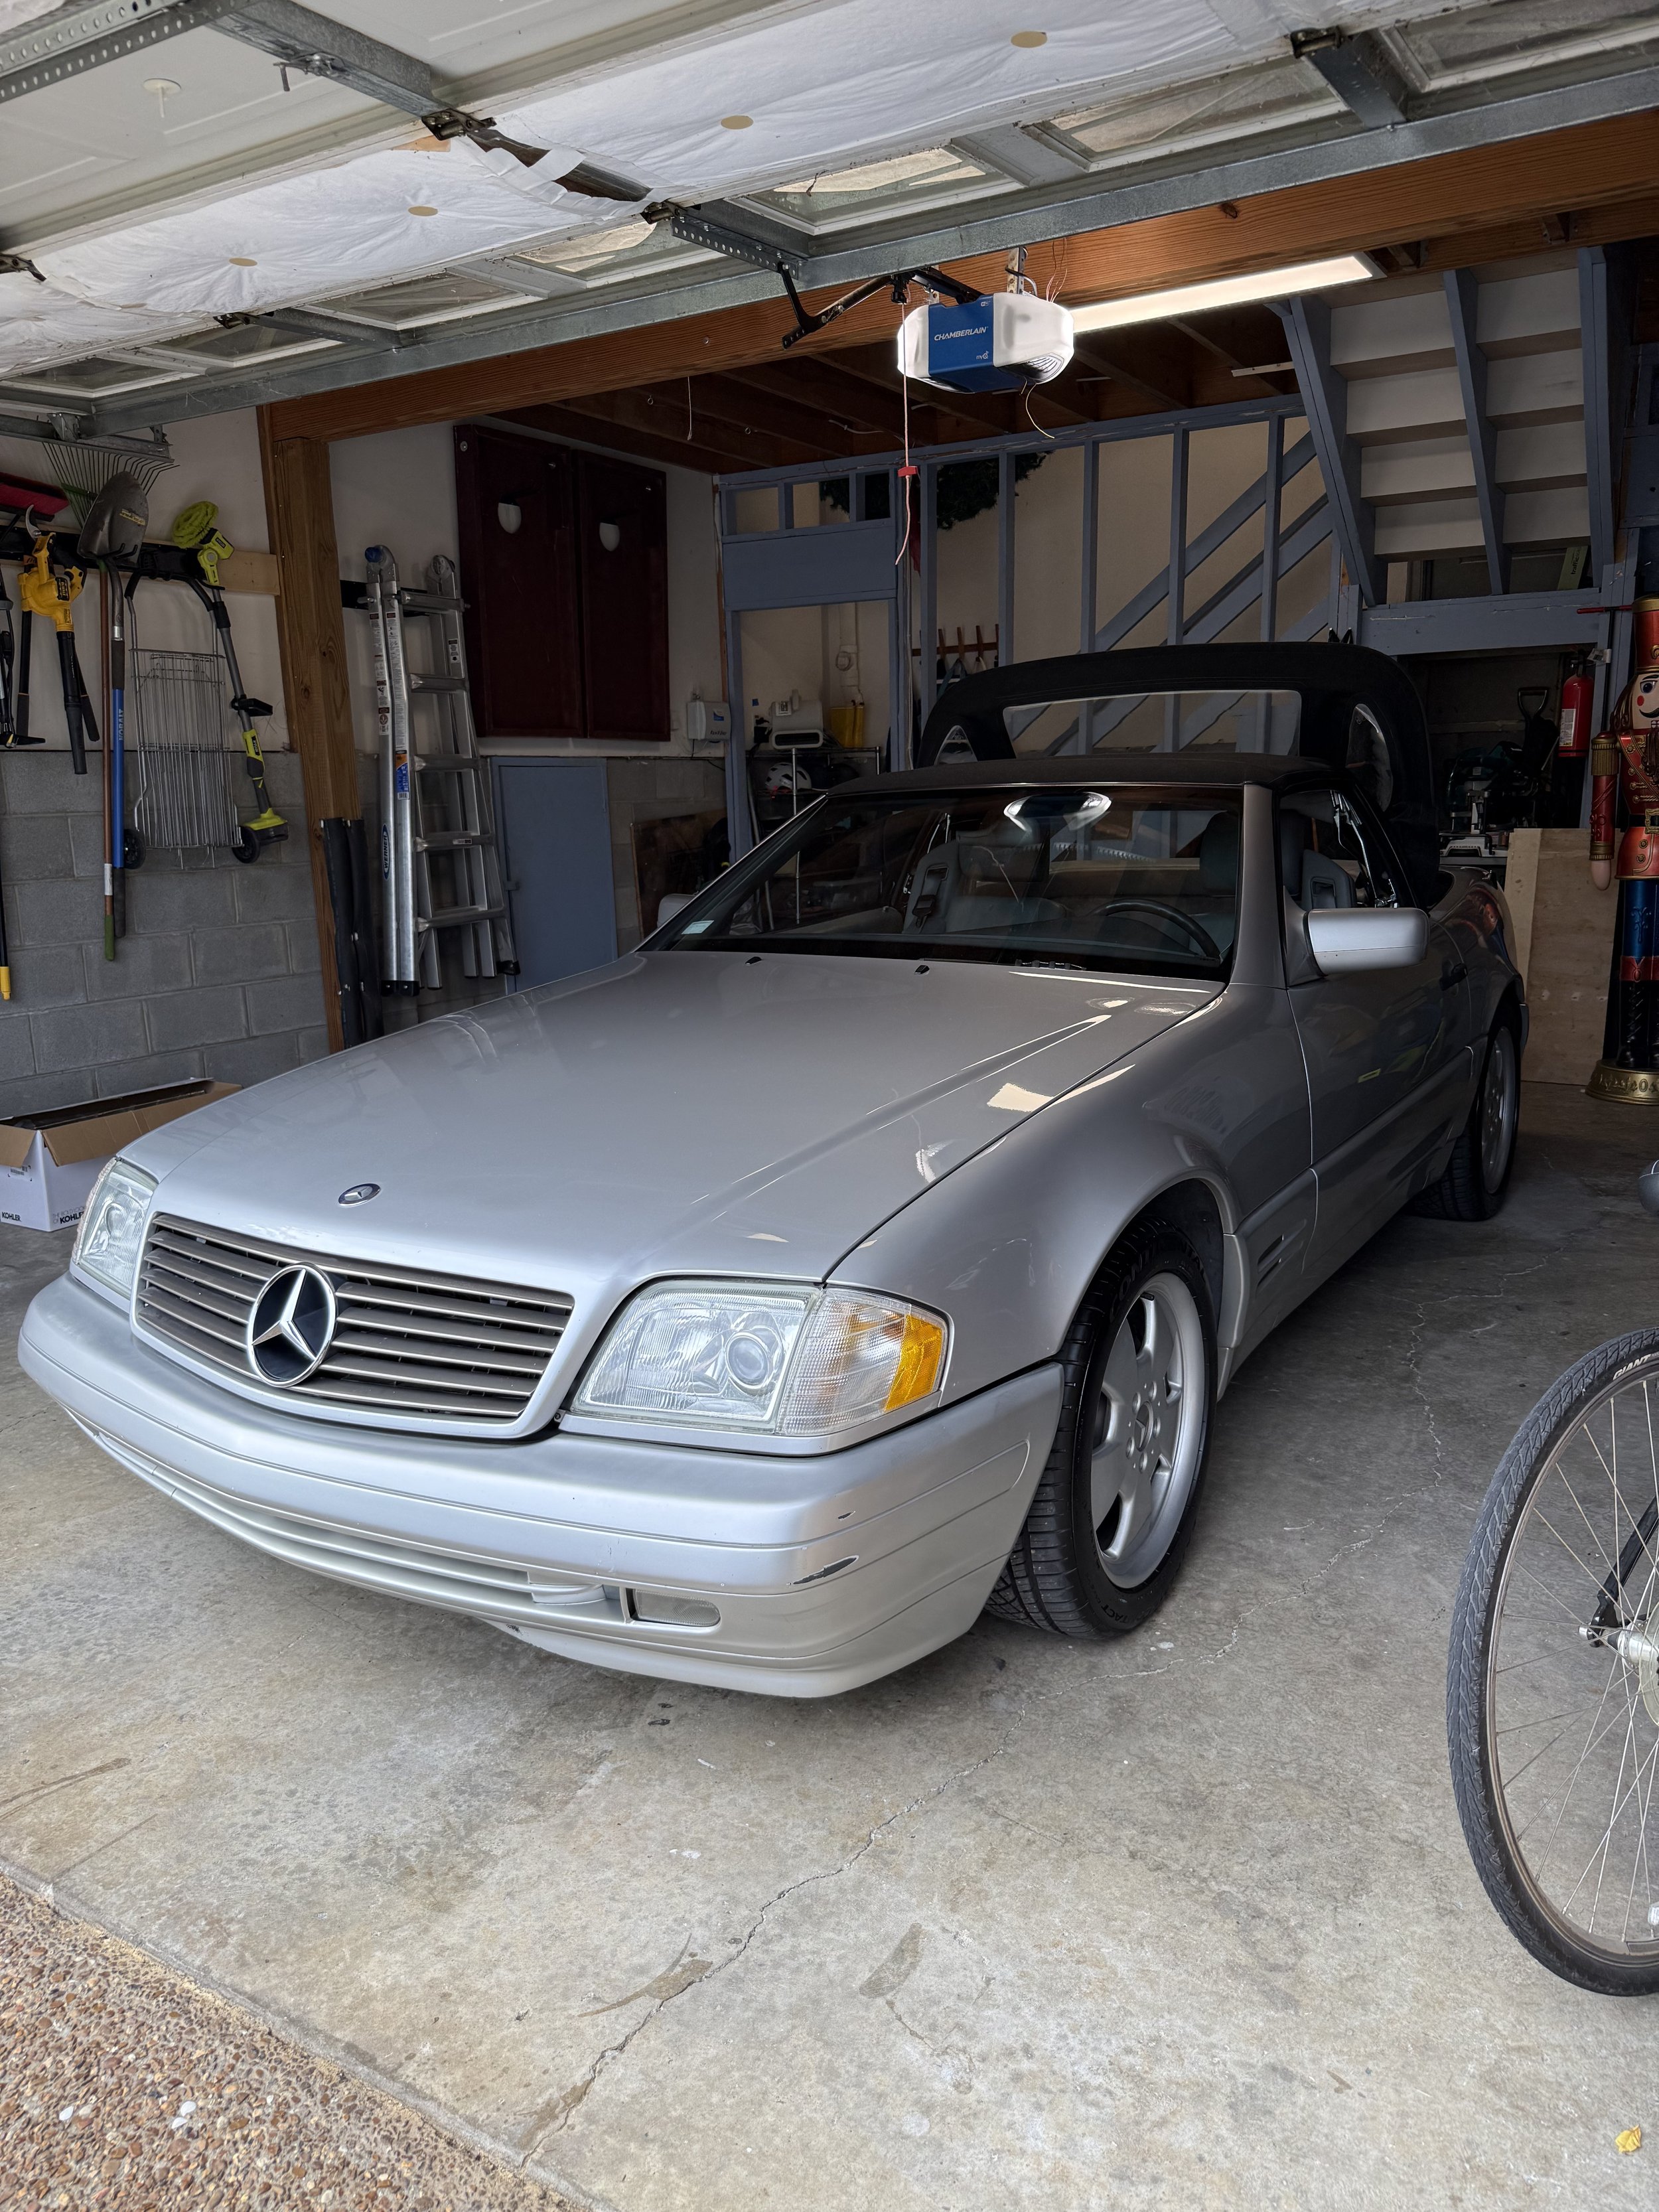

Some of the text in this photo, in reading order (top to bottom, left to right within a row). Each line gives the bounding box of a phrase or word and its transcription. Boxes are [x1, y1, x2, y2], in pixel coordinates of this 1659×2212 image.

[934, 327, 987, 341] CHAMBERLAIN
[1, 1211, 23, 1222] KOHLER
[1613, 1354, 1651, 1380] GIANT
